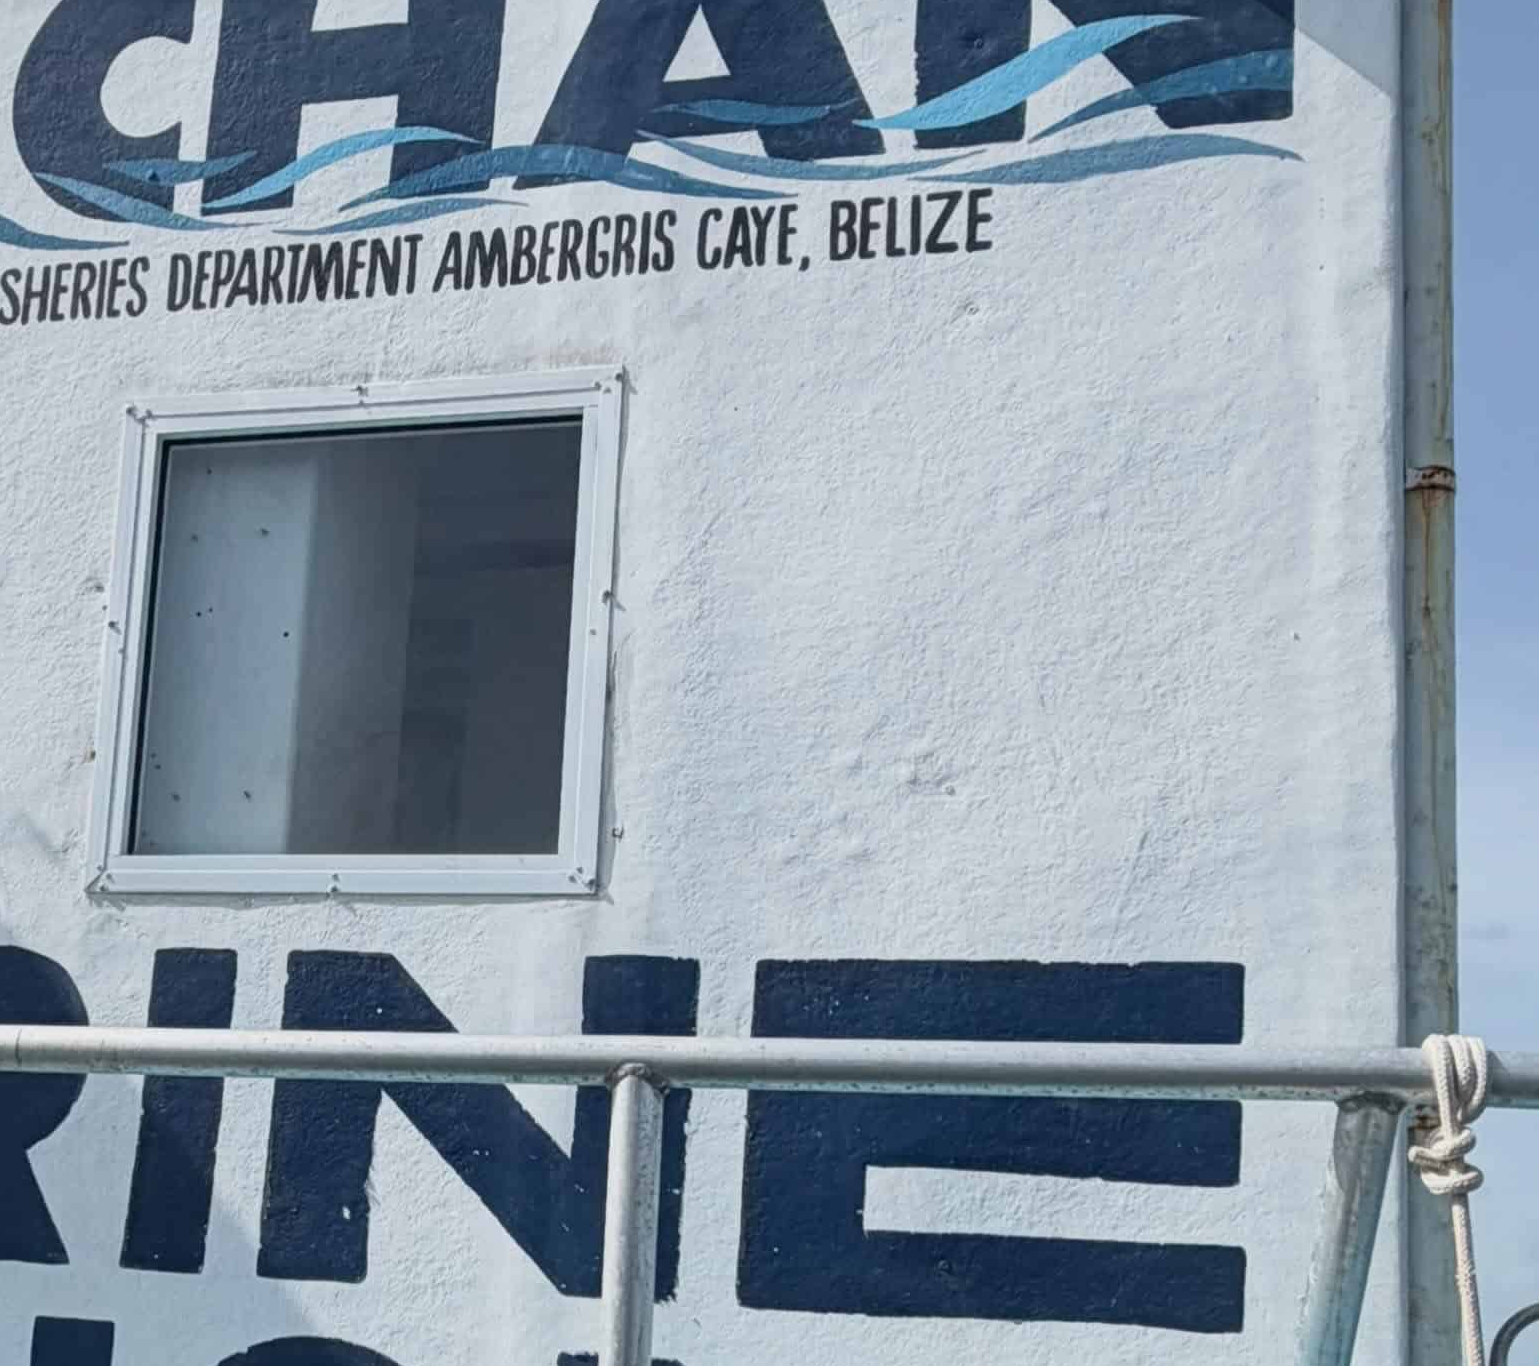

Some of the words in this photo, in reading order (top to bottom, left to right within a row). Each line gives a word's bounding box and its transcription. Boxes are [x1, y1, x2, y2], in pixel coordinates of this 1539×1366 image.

[166, 233, 423, 313] DEPARTMENT
[432, 209, 678, 292] AMBERGRIS
[696, 203, 812, 272] CAYE,
[828, 187, 995, 261] BELIZE
